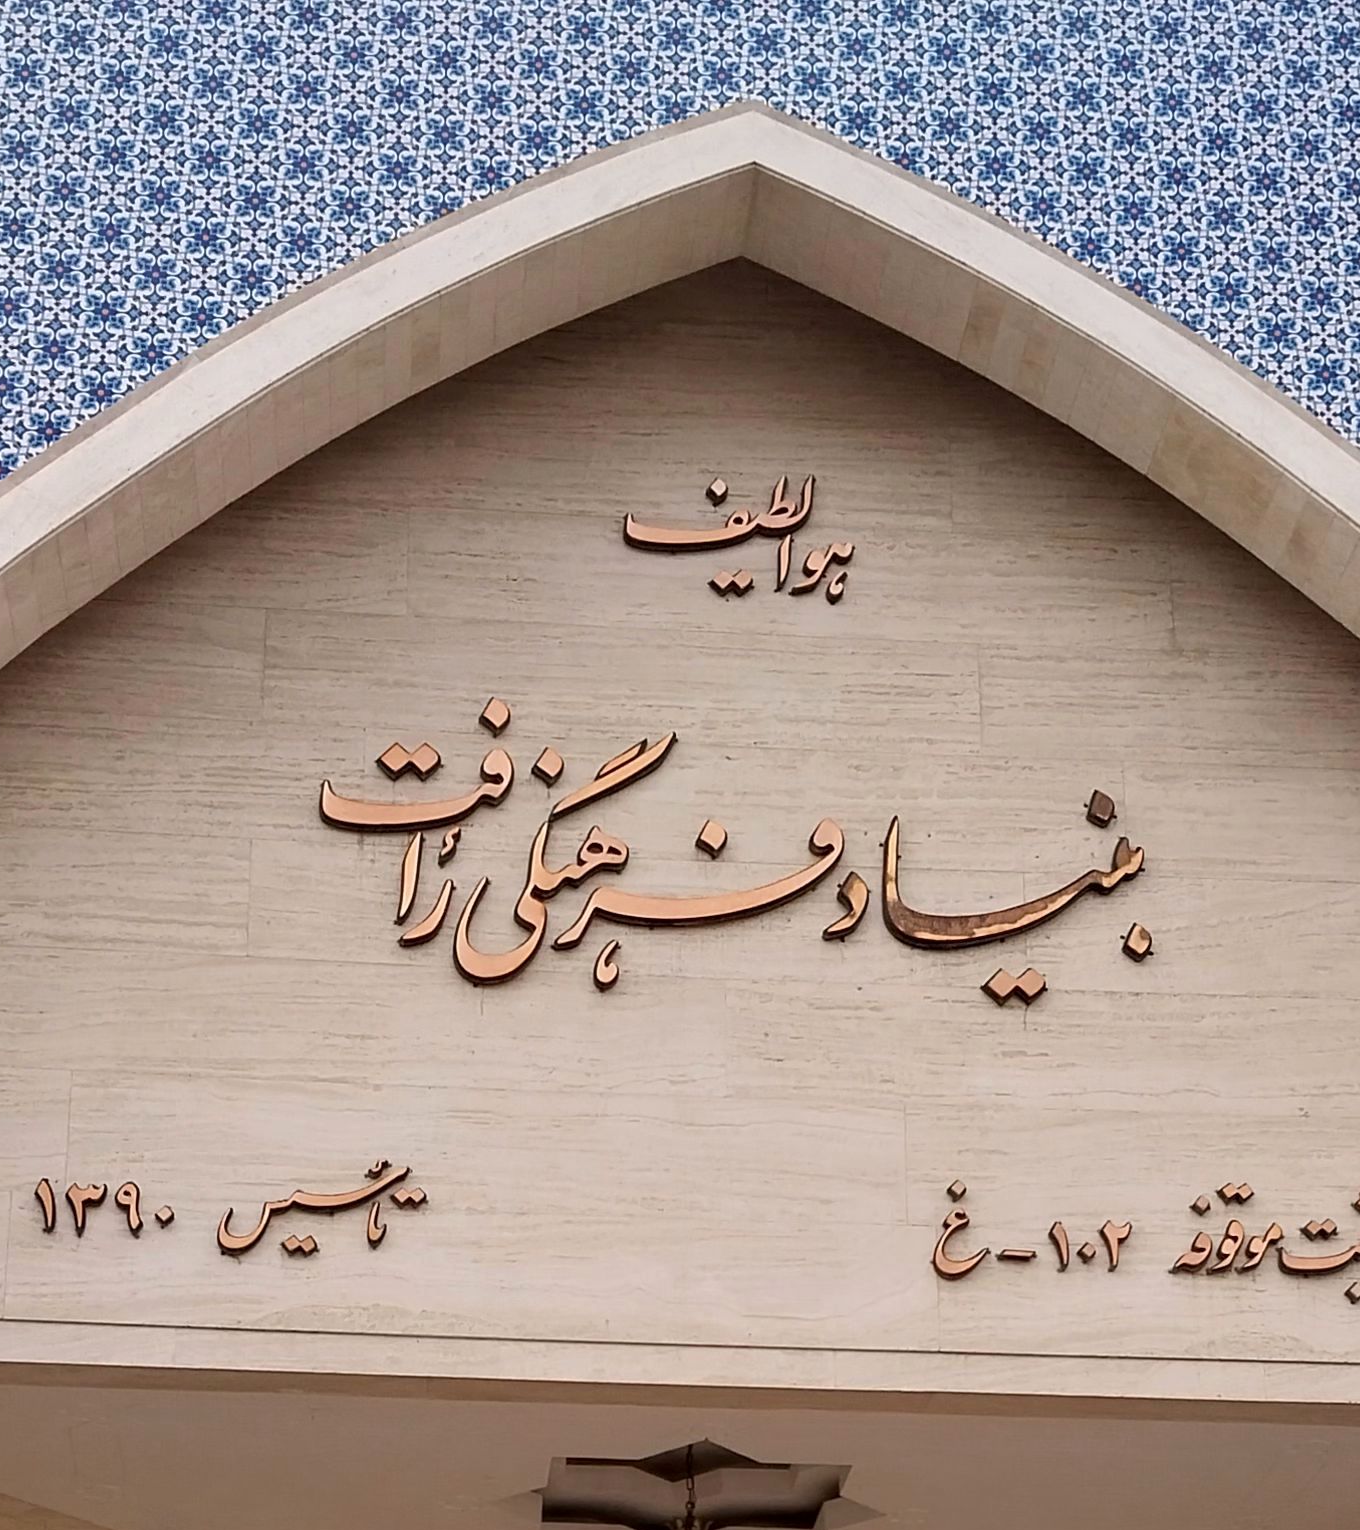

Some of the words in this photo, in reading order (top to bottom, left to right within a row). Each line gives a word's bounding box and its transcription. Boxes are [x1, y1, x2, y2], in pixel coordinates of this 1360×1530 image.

[453, 730, 845, 993] فرهنگی
[823, 788, 1154, 1006] بنیاد
[34, 1177, 174, 1238] ۱۳۹۰
[1170, 1182, 1285, 1277] موقوفه
